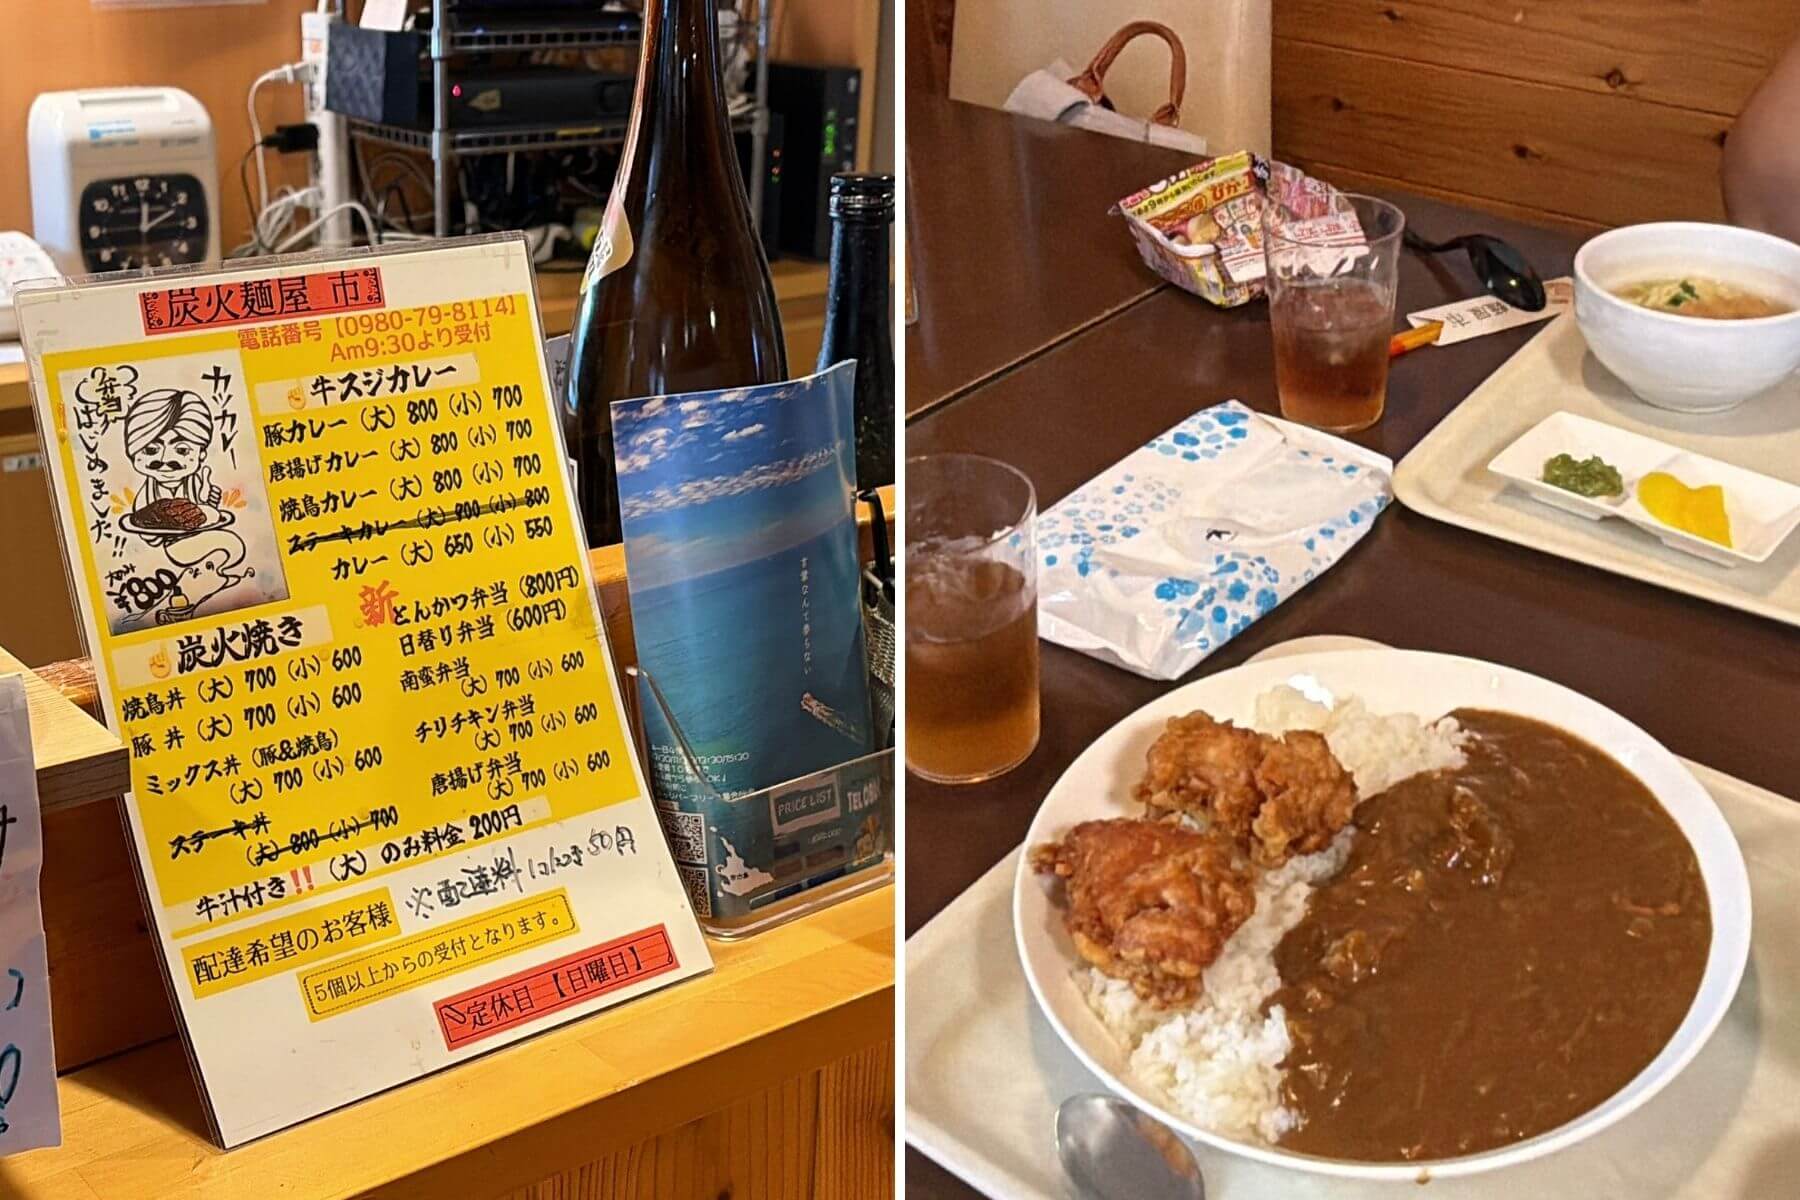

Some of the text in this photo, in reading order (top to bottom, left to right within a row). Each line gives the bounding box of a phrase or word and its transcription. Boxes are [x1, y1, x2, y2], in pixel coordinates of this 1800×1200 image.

[167, 270, 360, 327] 炭火麺屋 市
[237, 320, 323, 351] 電話番号
[329, 321, 492, 363] Am9:30より受付
[309, 362, 458, 405] 牛スジカレー
[263, 418, 348, 449] 豚カレー
[269, 448, 379, 484] 唐揚げカレー
[278, 487, 379, 523] 焼鳥カレー
[331, 551, 389, 581] カレー
[393, 580, 509, 627] とんかつ弁当
[176, 614, 304, 675] 炭火焼き
[398, 614, 496, 657] 日替り弁当
[400, 656, 471, 693] 南蛮弁当
[122, 687, 186, 723] 焼鳥丼
[415, 693, 536, 744] チリチキン弁当
[145, 753, 242, 797] ミックス丼
[430, 751, 523, 797] 唐揚げ弁当
[777, 795, 807, 817] PRICE
[191, 899, 394, 986] 配達希望のお客様
[466, 984, 535, 1031] 定休日
